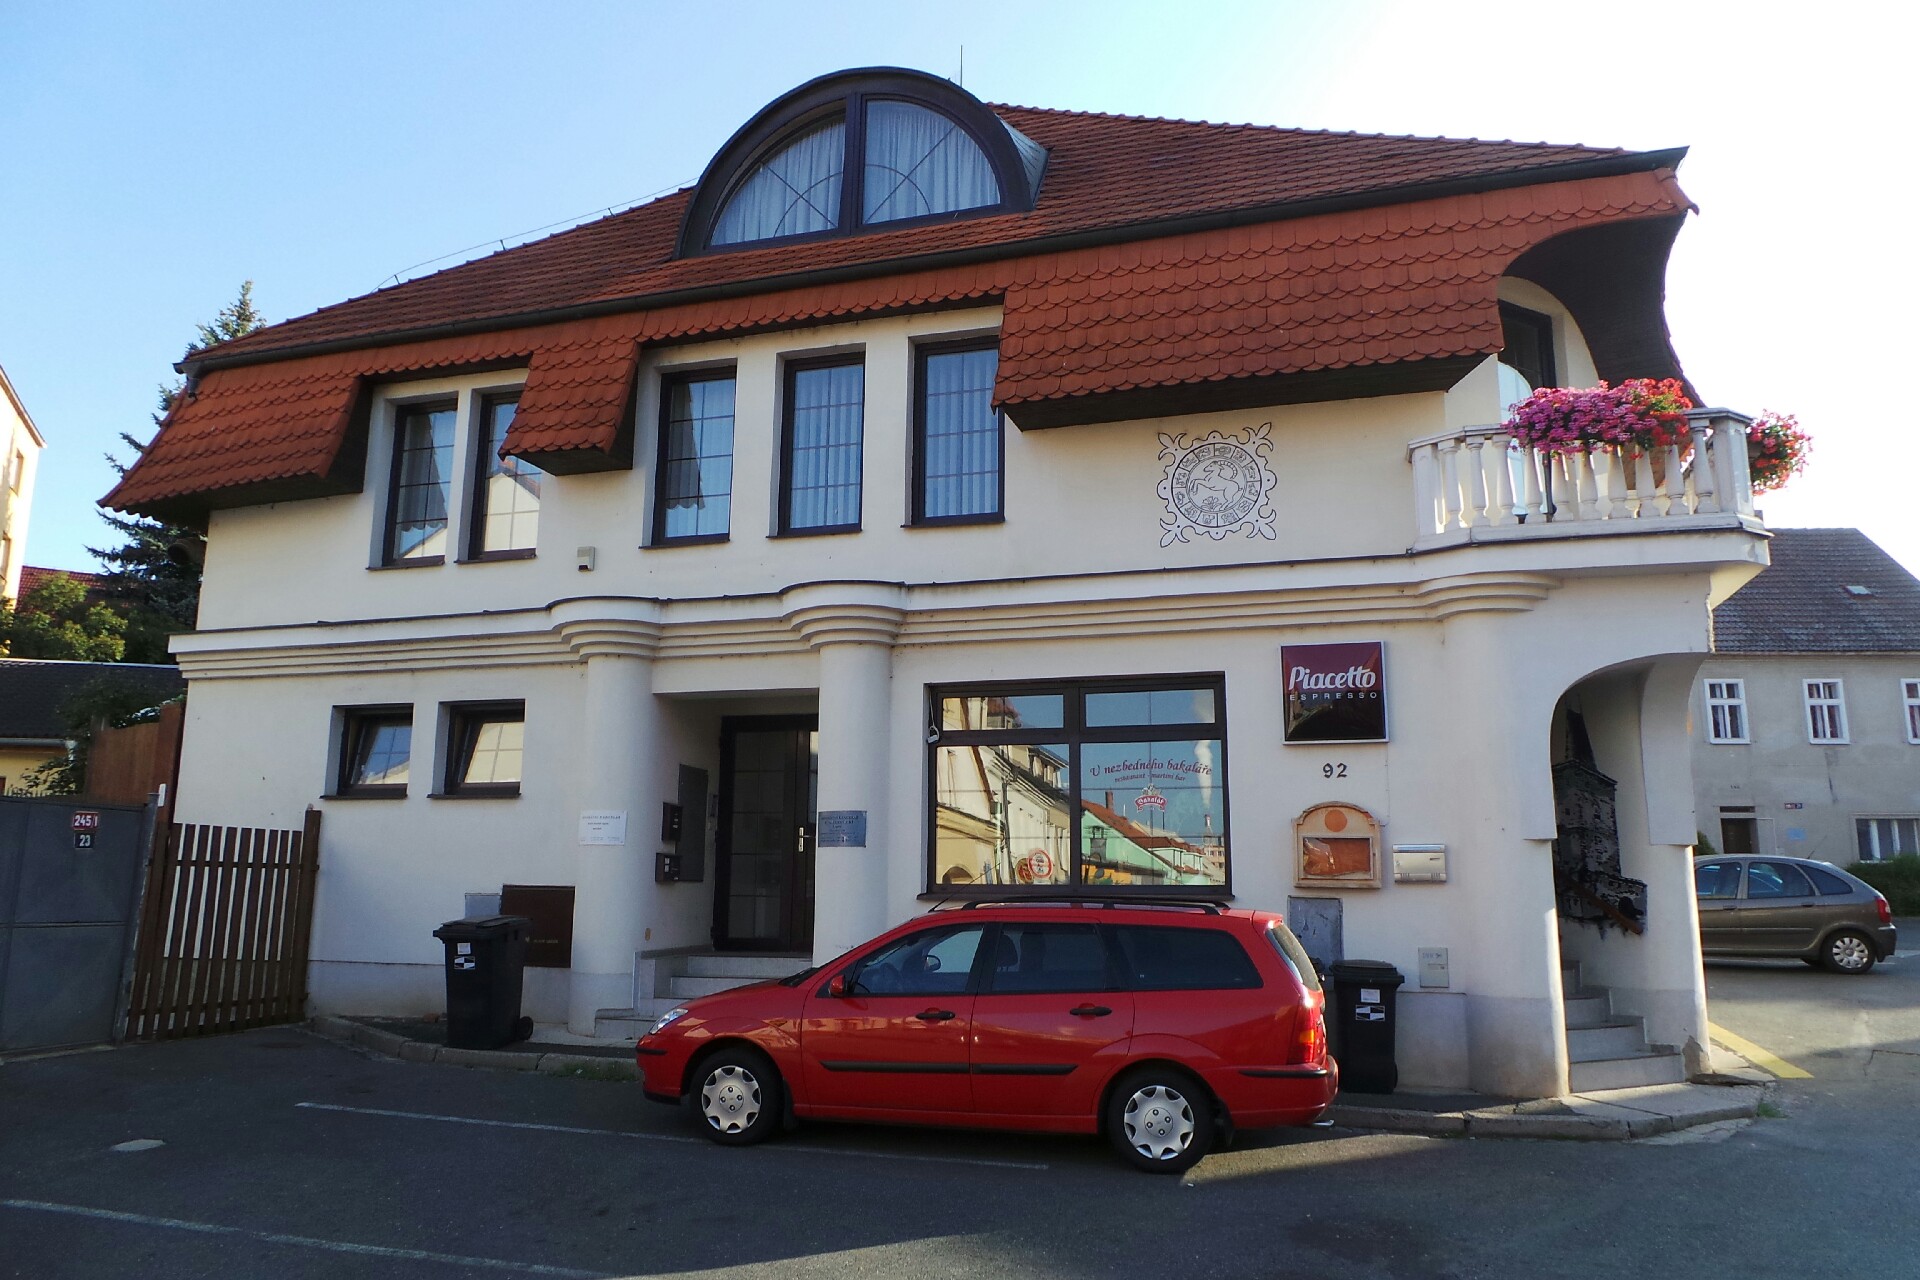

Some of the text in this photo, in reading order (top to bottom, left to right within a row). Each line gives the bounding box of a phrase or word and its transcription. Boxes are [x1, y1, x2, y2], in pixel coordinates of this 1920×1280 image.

[1289, 666, 1376, 690] Piacetto
[1290, 692, 1377, 701] ESPRESSO
[1089, 759, 1212, 776] U nezbedného bakaláře
[1322, 762, 1348, 779] 92
[79, 834, 91, 847] 23
